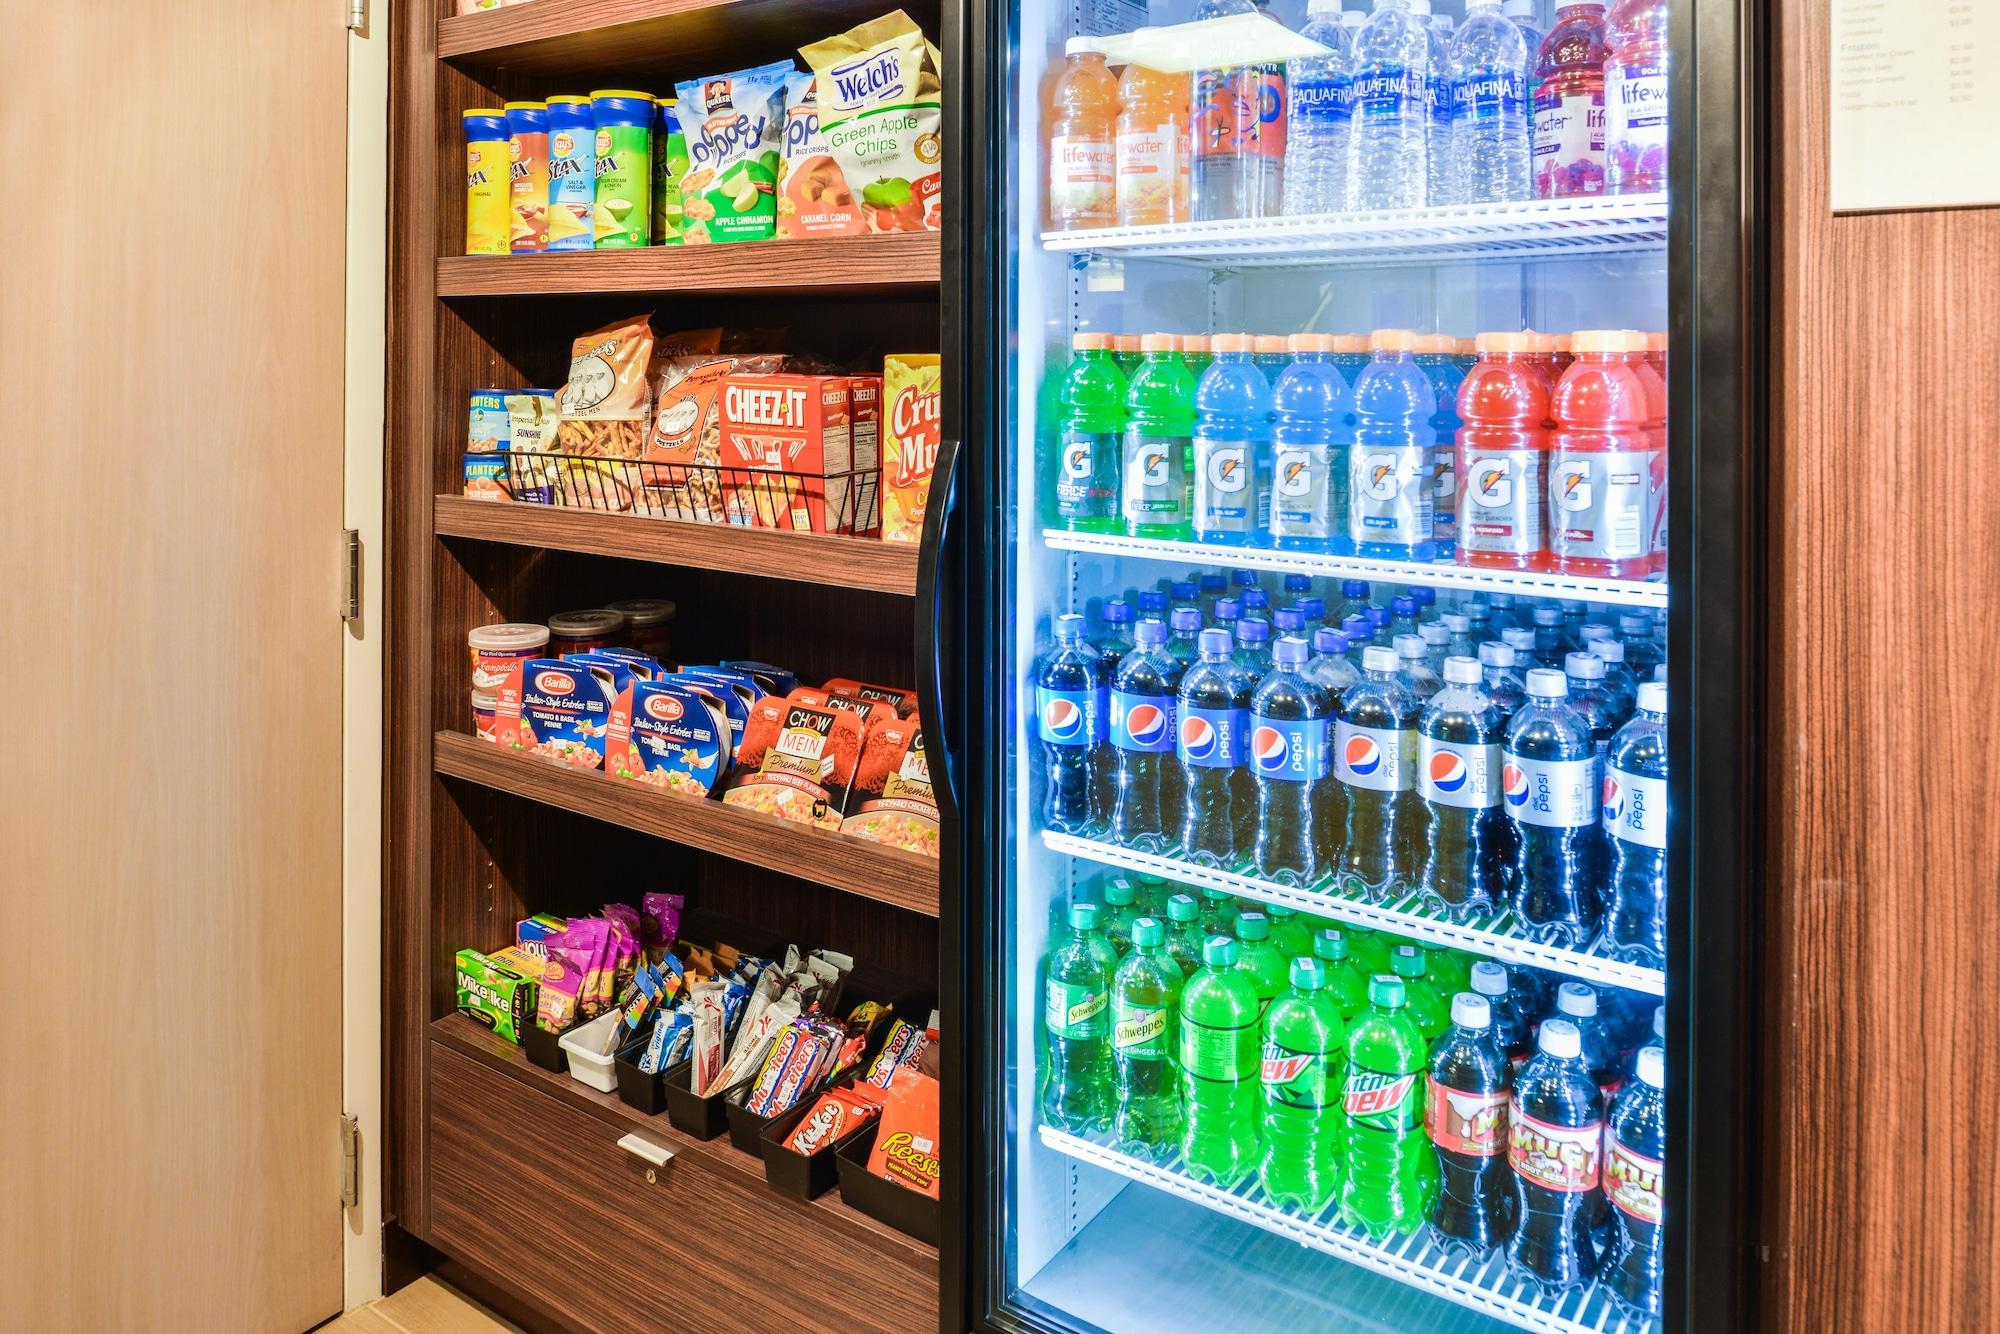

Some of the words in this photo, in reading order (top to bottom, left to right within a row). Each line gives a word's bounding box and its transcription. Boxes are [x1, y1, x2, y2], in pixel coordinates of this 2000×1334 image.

[836, 56, 900, 103] Welch's
[707, 95, 731, 108] QUAKER
[1453, 80, 1513, 103] AQUAFINA
[832, 122, 875, 148] Green
[881, 116, 918, 134] Apple
[796, 147, 808, 155] RICE
[809, 145, 829, 154] CRISPS
[855, 138, 897, 157] Chips
[715, 216, 736, 226] APPLE
[736, 214, 774, 225] CINNAMON
[801, 214, 829, 224] CARAMEL
[830, 213, 851, 223] CORN
[517, 428, 542, 440] SUNSHINE
[656, 438, 684, 447] PRETZELS
[1064, 442, 1094, 479] G
[1126, 443, 1169, 487] G
[1208, 448, 1246, 493] G
[1276, 450, 1311, 497] G
[1361, 453, 1398, 501] G
[1468, 457, 1512, 508] G
[1553, 460, 1592, 512] G
[544, 677, 572, 690] Barilla
[532, 712, 554, 721] TOMATO
[560, 715, 575, 723] BASIL
[653, 700, 680, 715] Barilla
[828, 700, 870, 718] CHOW
[1083, 700, 1095, 735] pepsi
[544, 721, 563, 729] PENNE
[789, 711, 832, 732] CHOW
[667, 743, 682, 752] BASIL
[783, 734, 820, 754] MEIN
[1217, 720, 1231, 759] pepsi
[1290, 731, 1304, 772] pepsi
[768, 754, 822, 776] Premium
[804, 781, 822, 795] FLAVOR
[1536, 773, 1552, 813] pepsi
[908, 801, 932, 814] CHICKEN
[1631, 788, 1645, 831] pepsi
[458, 970, 488, 1000] Mike
[490, 989, 510, 1013] Ike
[1070, 997, 1107, 1021] Schweppes
[1117, 1017, 1164, 1042] Schweppes
[902, 1168, 917, 1180] BUTTER
[917, 1177, 929, 1187] CUPS
